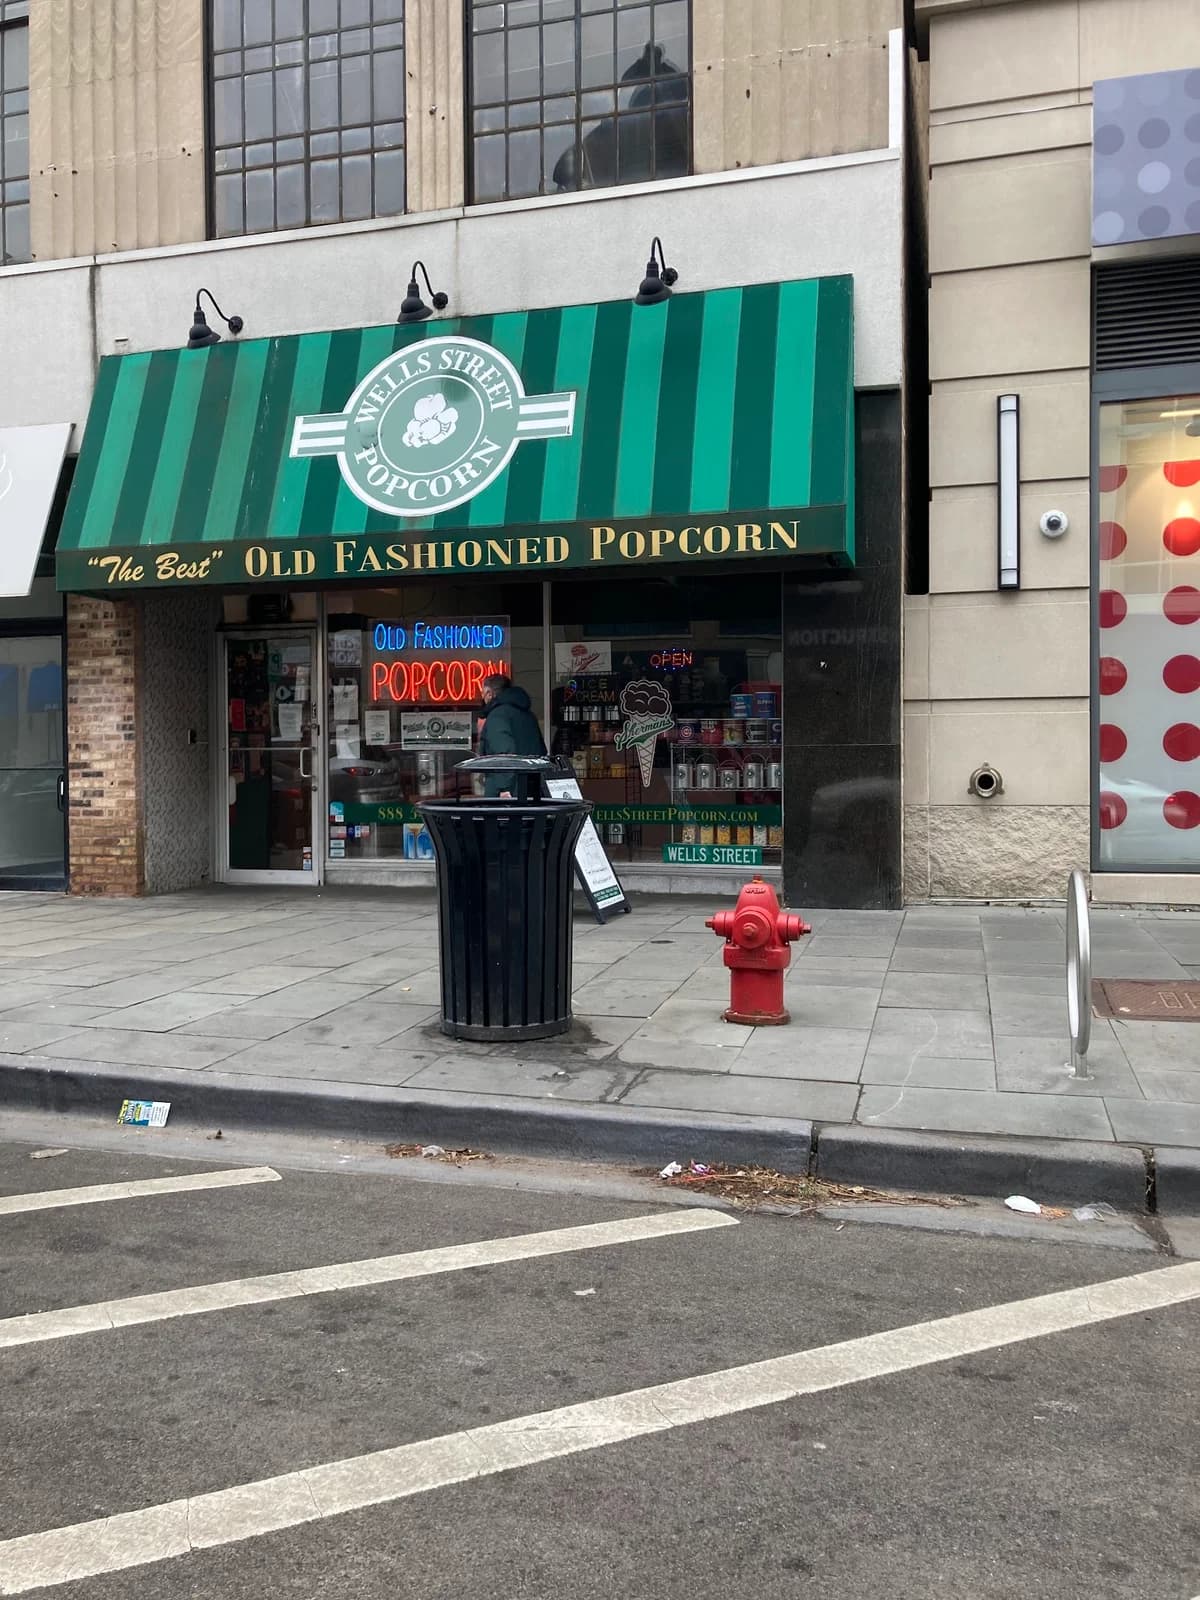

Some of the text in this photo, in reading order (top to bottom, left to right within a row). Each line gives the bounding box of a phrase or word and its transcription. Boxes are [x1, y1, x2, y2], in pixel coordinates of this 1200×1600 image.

[354, 348, 513, 425] WELLS STREET
[354, 435, 502, 501] POPCORN
[244, 546, 316, 577] OLD
[333, 535, 570, 573] FASHIONED
[589, 520, 800, 561] POPCORN
[374, 622, 504, 651] OLD FASHIONED
[649, 651, 693, 667] OPEN
[576, 690, 615, 703] CREAM
[378, 806, 404, 820] 888
[596, 807, 758, 823] ELLSSTREETPOPCORN.COM
[667, 846, 758, 864] WELLS STREET
